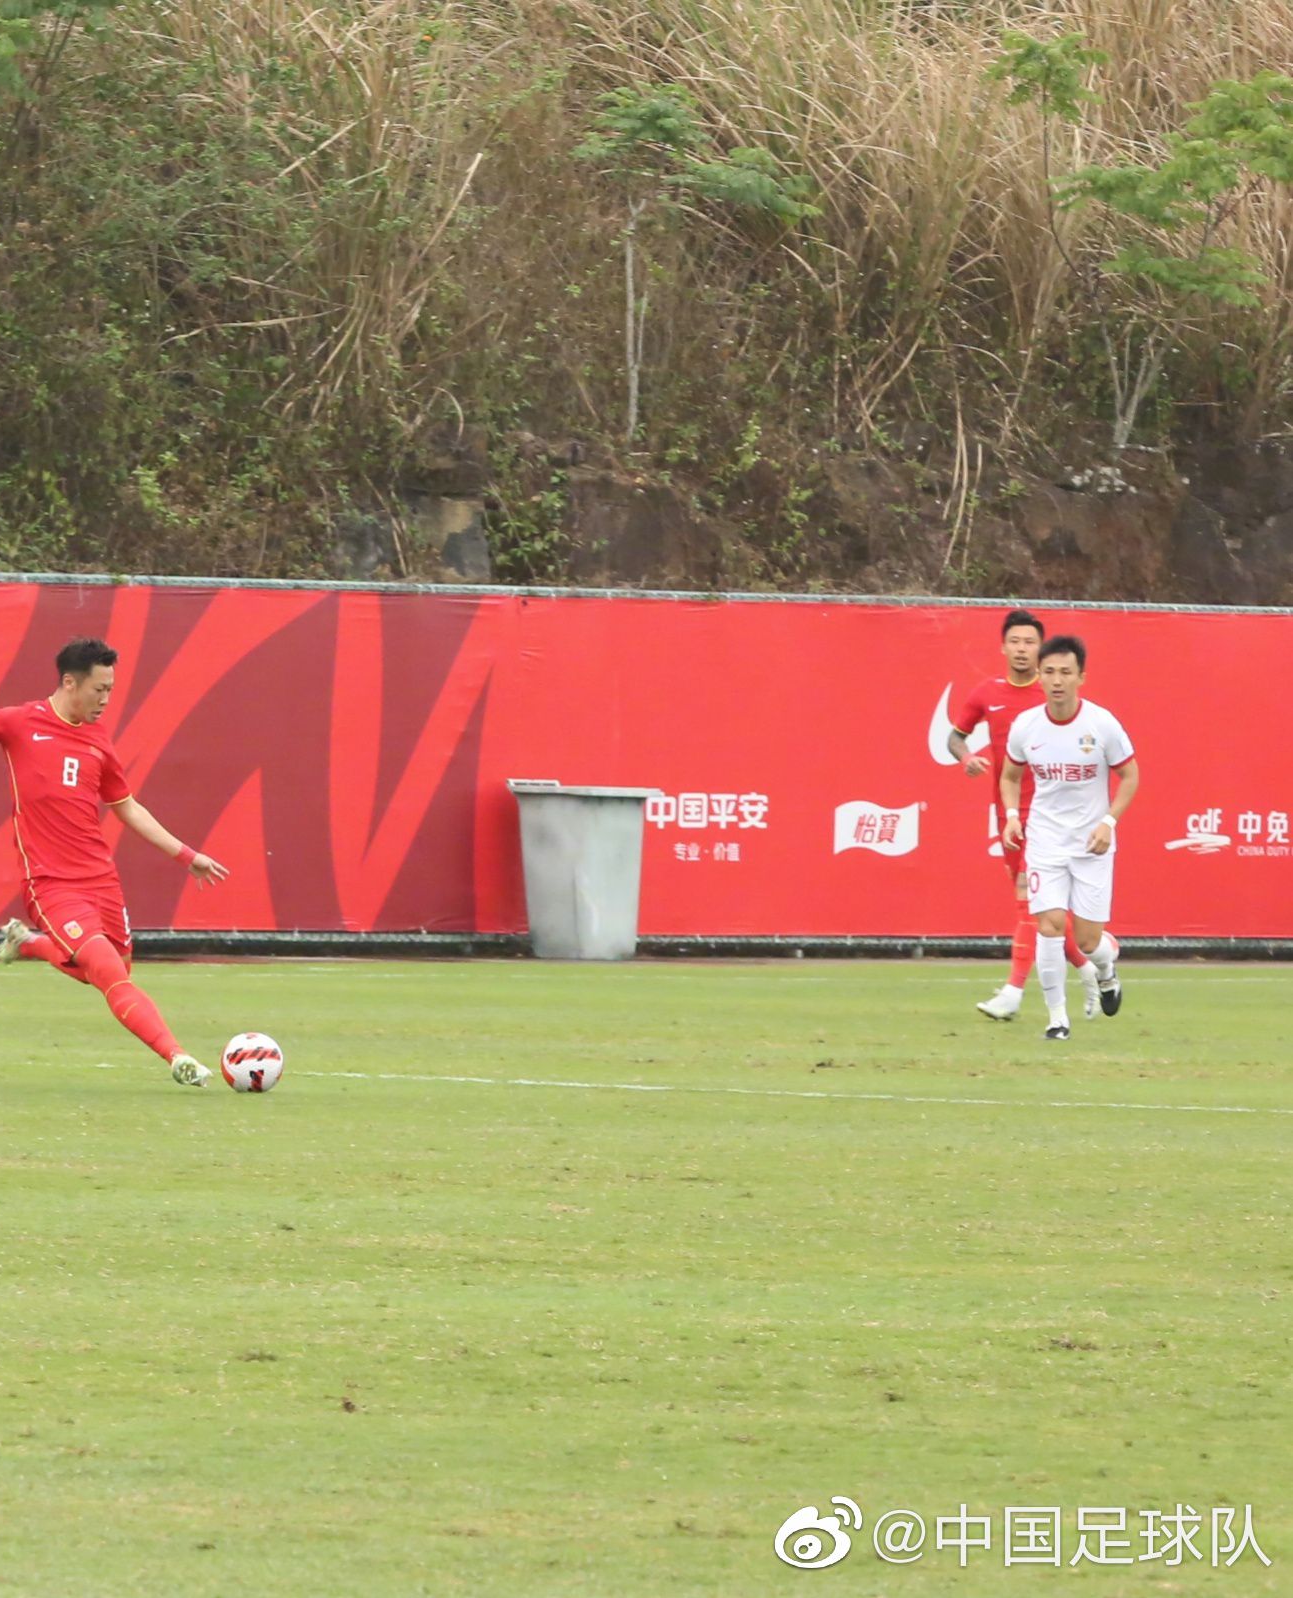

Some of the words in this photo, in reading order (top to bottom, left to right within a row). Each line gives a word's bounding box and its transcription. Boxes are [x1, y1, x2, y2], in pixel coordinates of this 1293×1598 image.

[62, 756, 79, 787] 8
[645, 791, 769, 830] 中国平安
[1186, 807, 1223, 834] cdf
[1237, 810, 1290, 843] 中免
